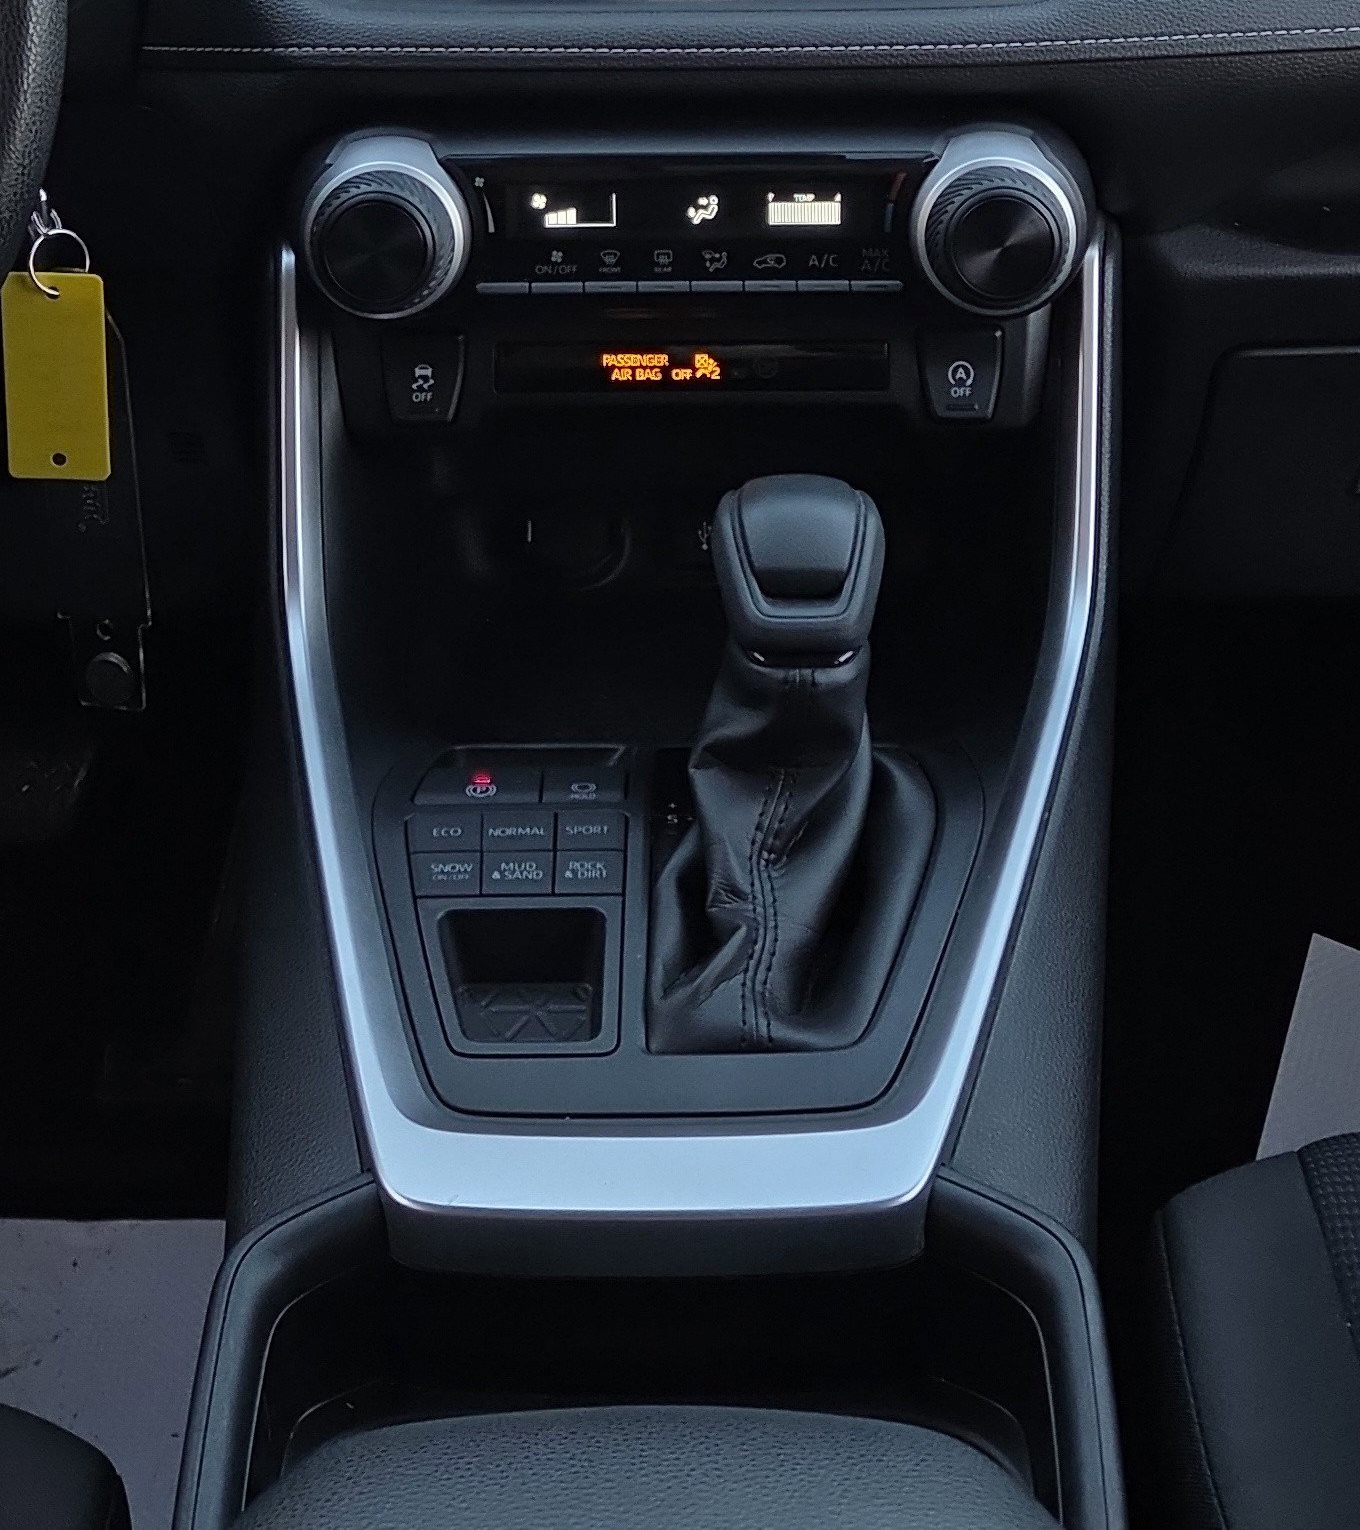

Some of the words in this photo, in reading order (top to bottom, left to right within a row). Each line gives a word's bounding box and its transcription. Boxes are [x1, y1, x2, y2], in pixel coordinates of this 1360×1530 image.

[808, 254, 839, 267] A/C
[535, 265, 578, 275] ON/OFF
[602, 354, 669, 367] PASSENGER
[611, 369, 632, 381] AIR
[635, 369, 662, 381] BAG
[671, 369, 692, 381] OFF
[412, 392, 433, 402] OFF
[951, 387, 972, 398] OFF
[433, 827, 462, 837] ECO
[489, 827, 545, 837] NORMAL
[565, 825, 608, 835] SPORT
[430, 863, 473, 873] SNOW
[500, 861, 537, 871] MUD
[569, 860, 605, 870] ROCK
[504, 870, 544, 880] SAND
[577, 870, 607, 879] DIRT
